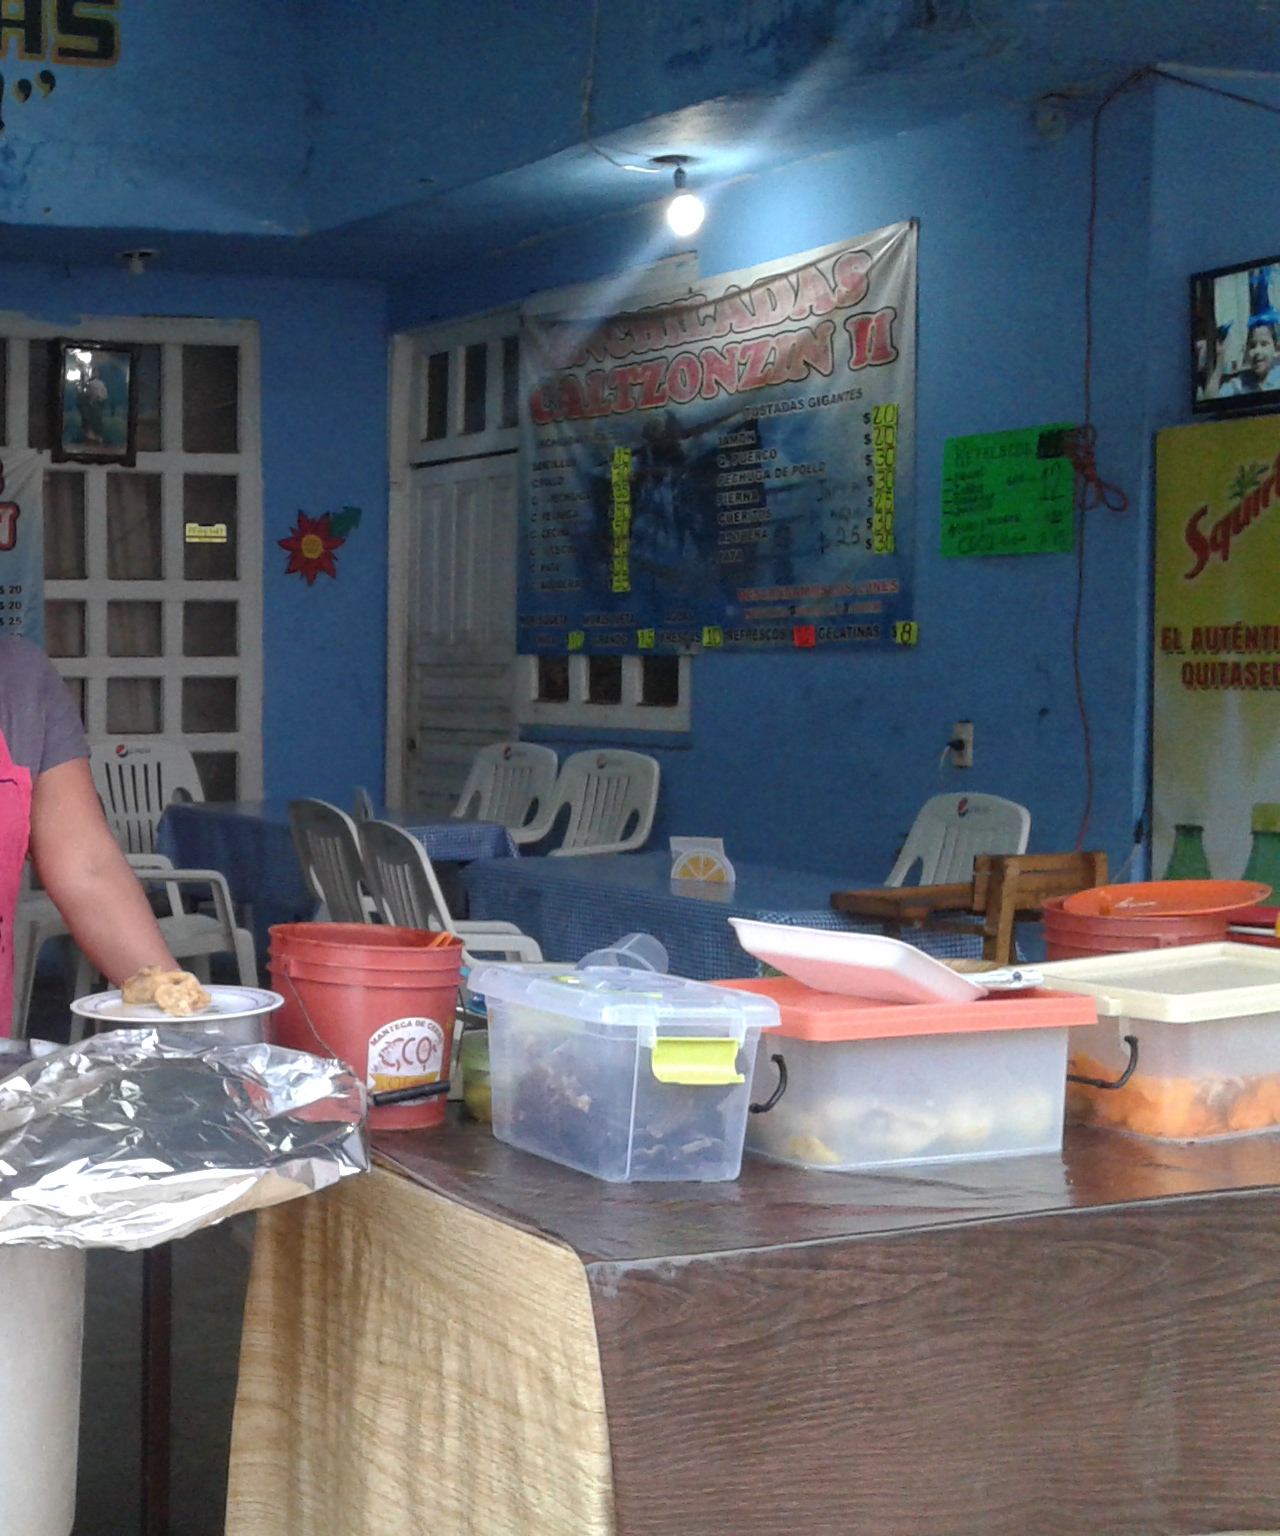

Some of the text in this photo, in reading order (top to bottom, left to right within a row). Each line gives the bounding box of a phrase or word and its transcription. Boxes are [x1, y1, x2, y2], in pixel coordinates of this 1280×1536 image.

[744, 386, 863, 419] TOSTADAS GIGANTES
[1161, 626, 1182, 651] EL
[370, 1019, 413, 1046] MANTECA
